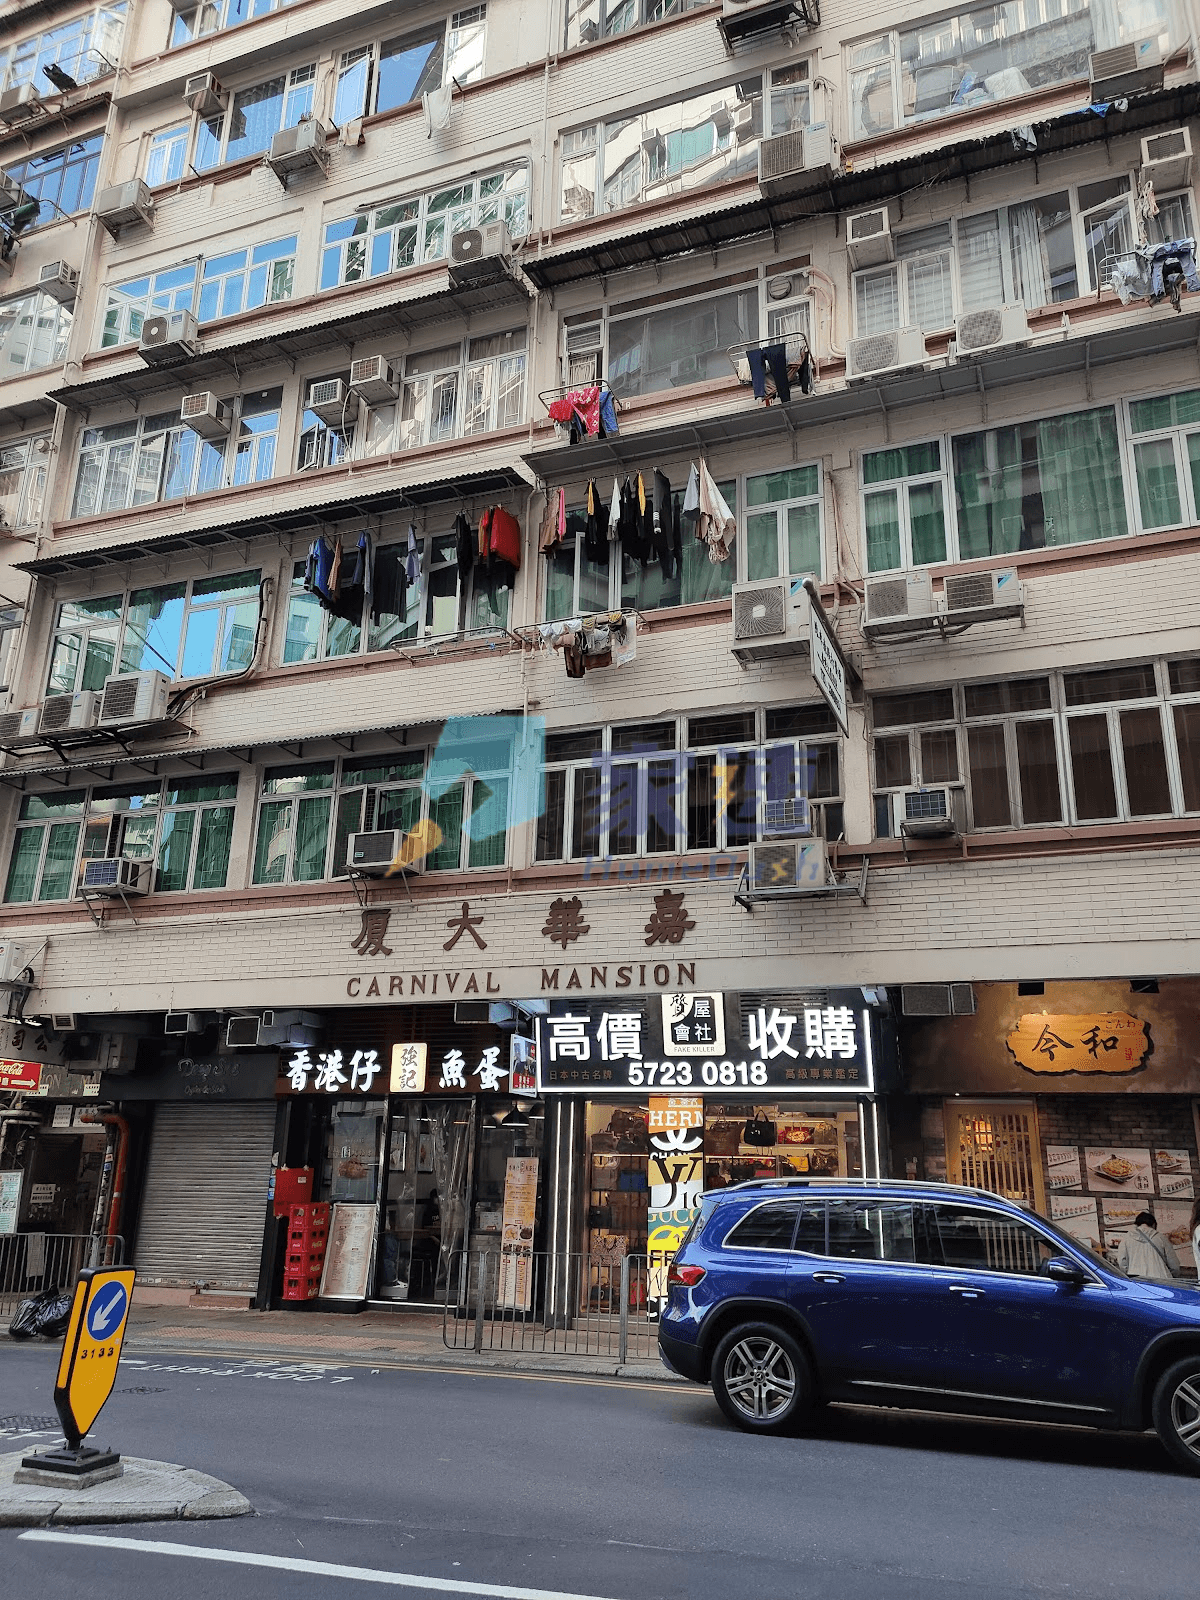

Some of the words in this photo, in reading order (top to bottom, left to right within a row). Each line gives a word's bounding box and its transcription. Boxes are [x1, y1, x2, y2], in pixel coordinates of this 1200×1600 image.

[347, 972, 500, 997] CARNIVAL
[541, 963, 695, 989] MANSION
[546, 1012, 644, 1062] 高價
[748, 1006, 858, 1060] 收購
[674, 1022, 713, 1042] 會社
[692, 1046, 716, 1054] KILLER
[286, 1049, 381, 1092] 香港仔
[438, 1046, 510, 1091] 魚蛋
[399, 1045, 418, 1090] 強記
[549, 1069, 613, 1081] 日本中古名牌
[628, 1060, 692, 1086] 5723
[701, 1060, 768, 1086] 0818
[785, 1068, 859, 1080] 高級專業鑑定
[81, 1347, 114, 1360] 3133
[129, 1364, 245, 1377] RIGHT
[243, 1371, 355, 1384] LOOK
